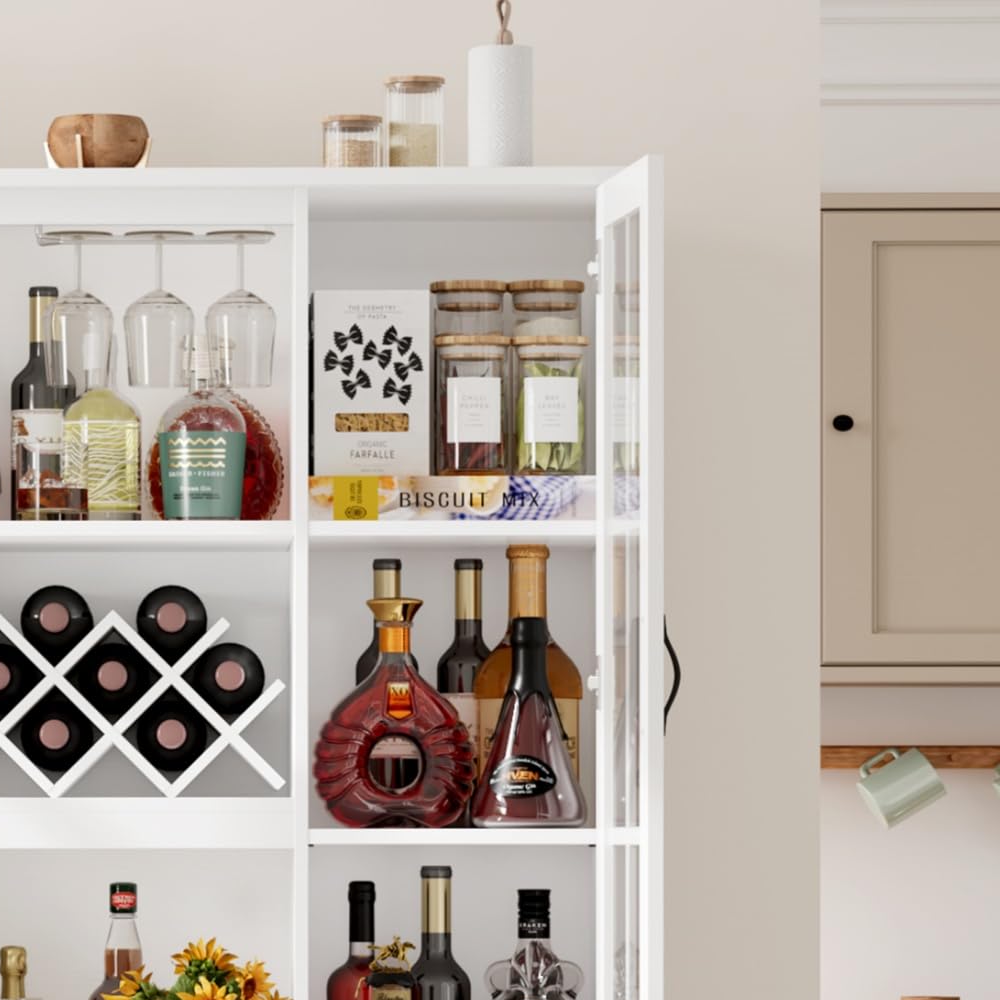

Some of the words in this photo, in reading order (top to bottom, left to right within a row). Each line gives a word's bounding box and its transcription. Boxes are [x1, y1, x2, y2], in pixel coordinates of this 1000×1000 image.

[350, 449, 395, 459] FARFALLE
[400, 492, 486, 508] BISCUIT
[502, 492, 540, 508] MIX
